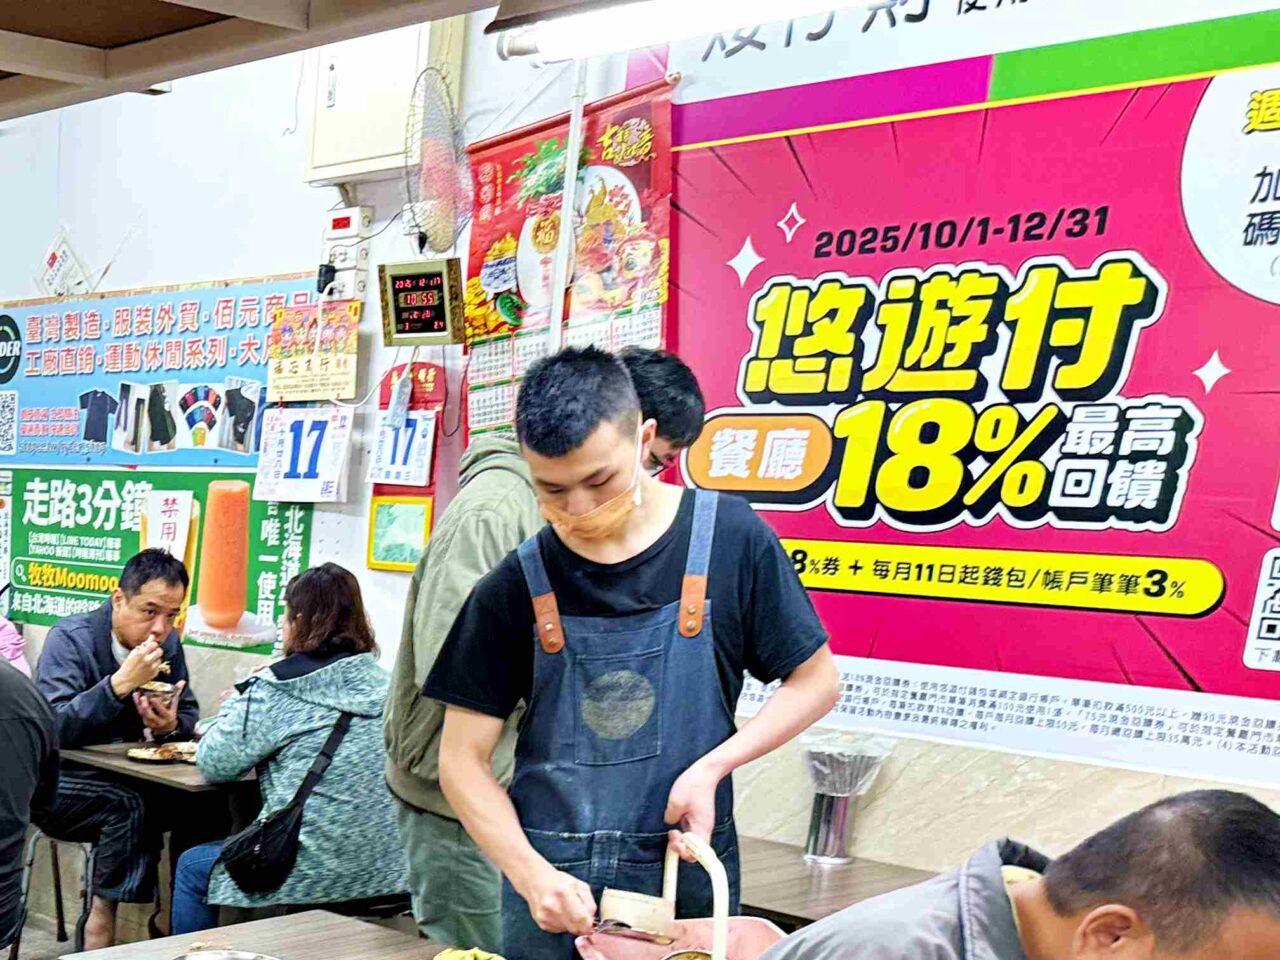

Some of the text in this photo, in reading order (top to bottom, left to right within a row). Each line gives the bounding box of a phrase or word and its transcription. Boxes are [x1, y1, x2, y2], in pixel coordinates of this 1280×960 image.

[814, 205, 1109, 259] 2025/10/1-12/31
[744, 260, 1148, 394] 悠遊付
[284, 419, 329, 479] 17
[390, 418, 418, 466] 17
[705, 427, 812, 481] 餐廳
[832, 398, 1060, 513] 18%
[1064, 403, 1183, 457] 最高
[1048, 457, 1166, 510] 回饋
[28, 562, 119, 592] 牧牧Moomoo
